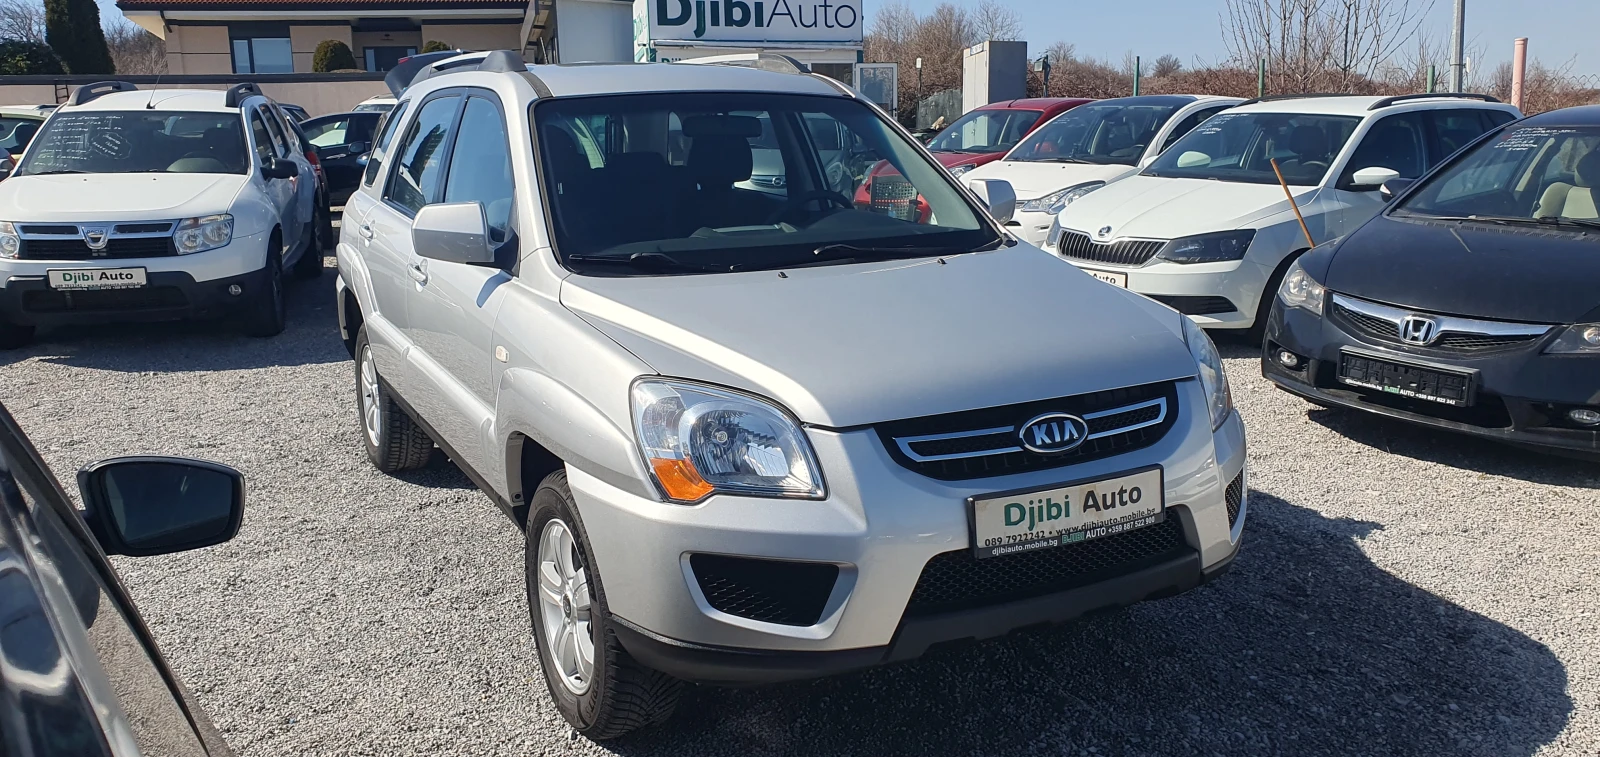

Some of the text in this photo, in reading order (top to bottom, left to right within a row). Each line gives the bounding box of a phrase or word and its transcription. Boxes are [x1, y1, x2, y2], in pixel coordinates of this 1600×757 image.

[62, 272, 134, 284] Djibi Auto
[1400, 388, 1415, 397] AUTO
[1032, 420, 1079, 446] KIA
[1004, 485, 1142, 531] Djibi Auto
[985, 536, 1003, 547] 089
[1006, 530, 1046, 544] 7922242
[992, 538, 1058, 556] djibiauto.mobile.bg
[1085, 527, 1107, 539] AUTO
[1108, 521, 1123, 533] +359
[1123, 519, 1134, 530] 887
[1134, 517, 1146, 528] 522
[1146, 516, 1156, 526] 900
